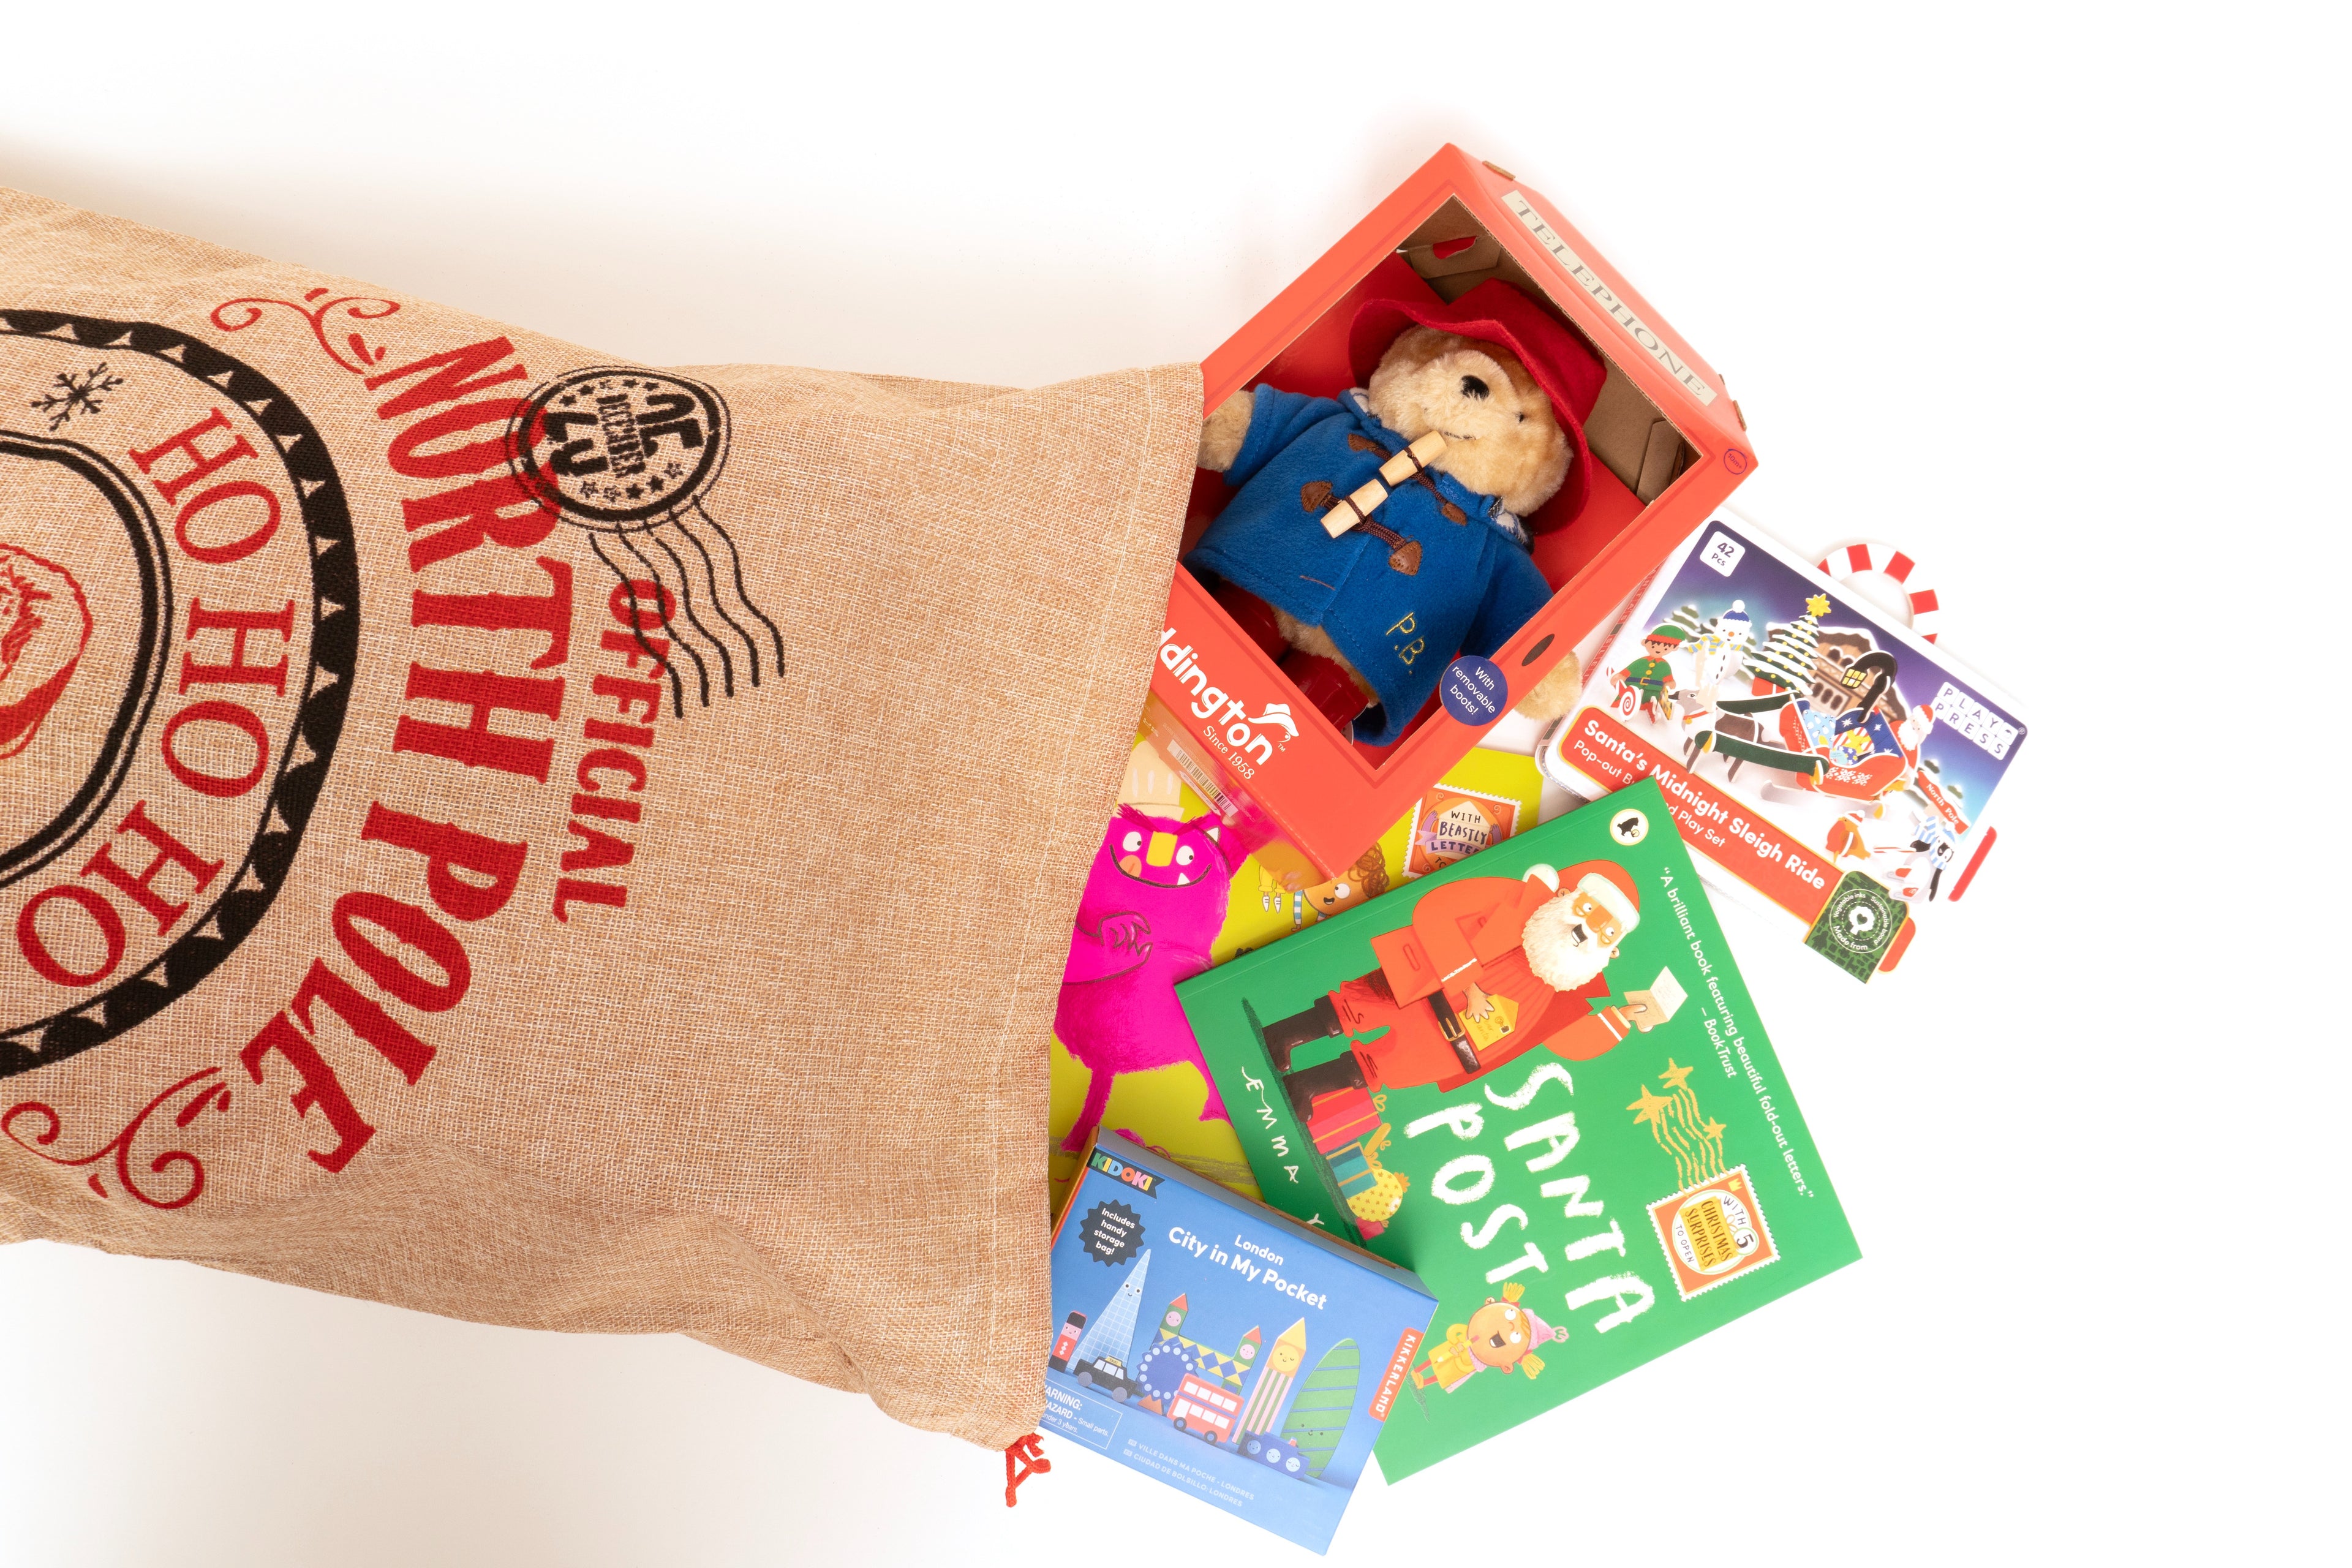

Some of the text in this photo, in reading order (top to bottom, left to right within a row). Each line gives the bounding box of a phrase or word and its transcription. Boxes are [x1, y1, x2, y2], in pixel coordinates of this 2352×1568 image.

[1518, 200, 1706, 396] TELEPHONE
[1717, 542, 1735, 558] 42
[17, 407, 295, 987] HO HO HO
[1450, 684, 1479, 715] boots!
[1452, 666, 1495, 714] removable
[1475, 666, 1494, 690] With
[1935, 703, 2003, 754] PRESS
[1943, 688, 1999, 728] PLAY
[240, 336, 573, 1174] NORTH POLE
[552, 579, 676, 923] OFFICIAL
[1203, 725, 1228, 754] Since
[1228, 752, 1255, 779] 1958
[1450, 810, 1481, 824] WITH
[1574, 739, 1623, 778] Pop-out
[1678, 810, 1704, 834] Play
[1705, 828, 1726, 847] Set
[1584, 720, 1825, 889] Santa's Midnight Sleigh Ride
[1926, 783, 1959, 825] North Pole
[1439, 821, 1487, 845] BEASTLY
[1833, 894, 1854, 918] Vegetable
[1871, 896, 1888, 945] Sustainable board
[1833, 925, 1868, 950] Made from
[1667, 888, 1695, 940] brilliant
[1691, 940, 1713, 976] book
[1706, 976, 1738, 1036] featuring
[1733, 1036, 1767, 1095] beautiful
[1759, 1095, 1788, 1148] fold-out
[1091, 1152, 1153, 1191] KIDOKI
[1403, 1102, 1549, 1284] POST
[1101, 1207, 1136, 1229] Includes
[1485, 1062, 1655, 1334] SANTA
[1723, 1195, 1754, 1248] WITH 5
[1093, 1229, 1125, 1248] storage
[1095, 1240, 1115, 1255] bag!
[1101, 1219, 1128, 1238] handy
[1234, 1234, 1284, 1266] London
[1675, 1224, 1695, 1263] TO OPEN
[1684, 1208, 1716, 1267] SURPRISES
[1701, 1200, 1733, 1262] CHRISTMAS
[1169, 1227, 1327, 1310] City in My Pocket
[1045, 1384, 1083, 1411] ARNING:
[1375, 1334, 1416, 1414] KIKKERLAND
[1046, 1400, 1072, 1419] AZARD
[1078, 1417, 1094, 1429] Small
[1134, 1453, 1161, 1470] CIUDAD
[1161, 1466, 1172, 1474] DE
[1208, 1487, 1243, 1507] LONDRES
[1139, 1443, 1158, 1457] VILLE
[1158, 1452, 1178, 1466] DANS
[1179, 1461, 1190, 1471] MA
[1191, 1468, 1216, 1483] POCHE
[1221, 1480, 1255, 1501] LONDRES
